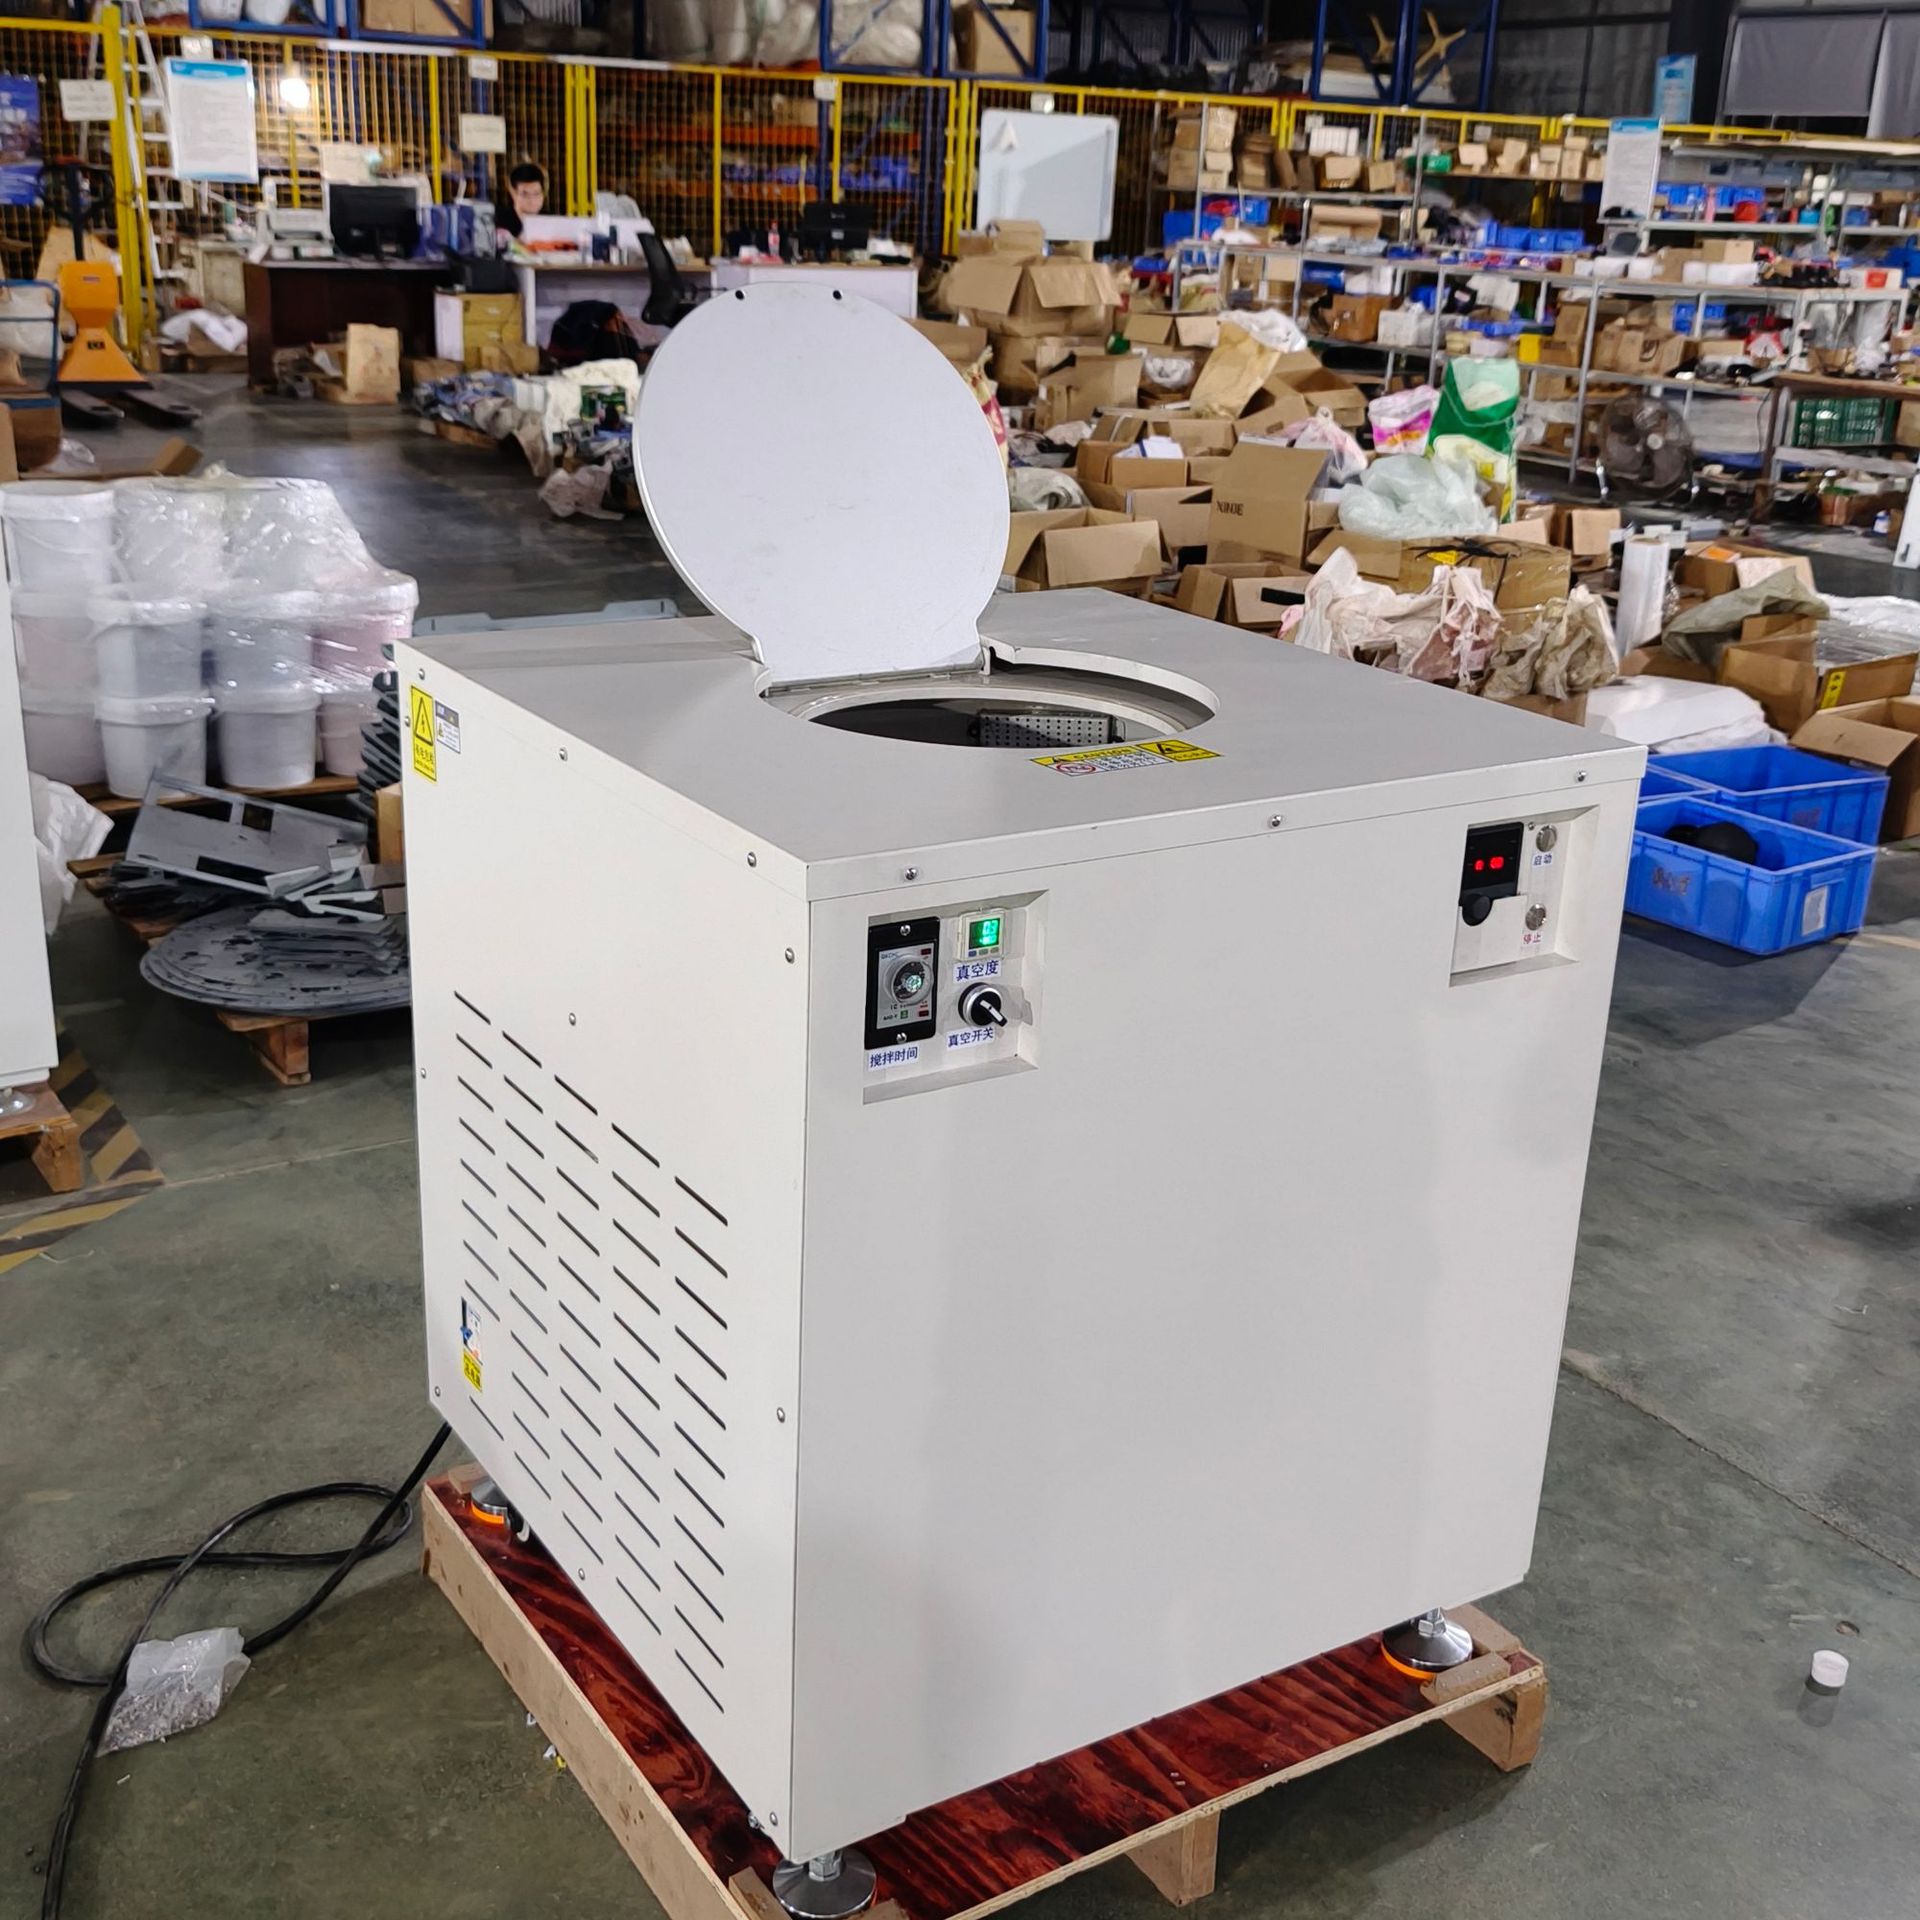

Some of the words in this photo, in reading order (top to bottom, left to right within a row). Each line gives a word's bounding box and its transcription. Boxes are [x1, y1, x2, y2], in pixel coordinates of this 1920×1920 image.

[1073, 749, 1133, 760] CAUTION
[1534, 854, 1552, 866] 启动
[1524, 933, 1541, 944] 停止
[957, 960, 999, 981] 真空度
[947, 1027, 995, 1047] 真空开关
[870, 1047, 918, 1067] 搅拌时间
